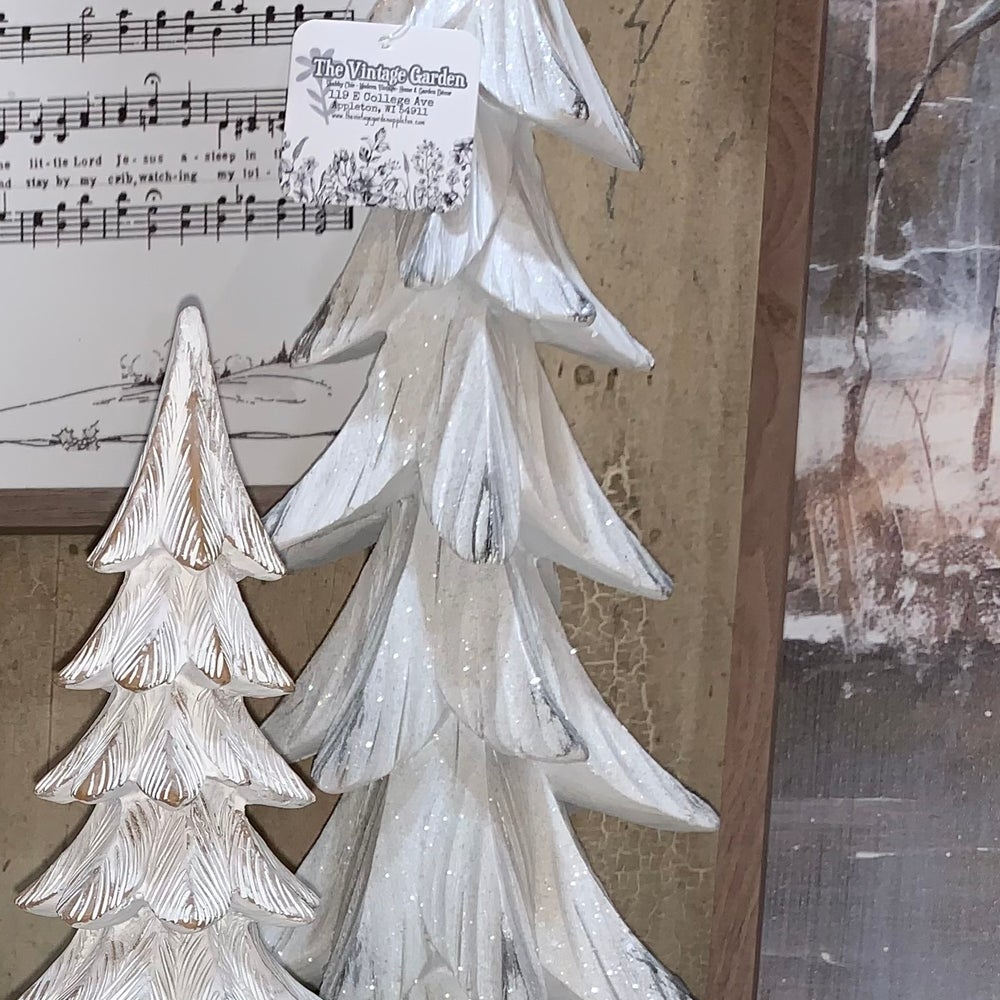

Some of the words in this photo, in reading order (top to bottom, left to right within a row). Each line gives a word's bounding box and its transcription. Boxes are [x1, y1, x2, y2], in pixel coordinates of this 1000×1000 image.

[312, 57, 345, 78] The
[347, 58, 409, 86] Vintage
[409, 64, 468, 88] Garden
[328, 89, 349, 99] 119
[353, 91, 360, 100] E
[364, 92, 410, 106] College
[414, 96, 434, 107] Ave
[331, 100, 381, 113] Appleton,
[385, 104, 396, 113] WI
[399, 105, 428, 116] 54911
[74, 155, 102, 167] Lord
[26, 177, 49, 189] stay
[56, 175, 70, 187] by
[80, 175, 97, 187] my
[217, 170, 235, 182] my
